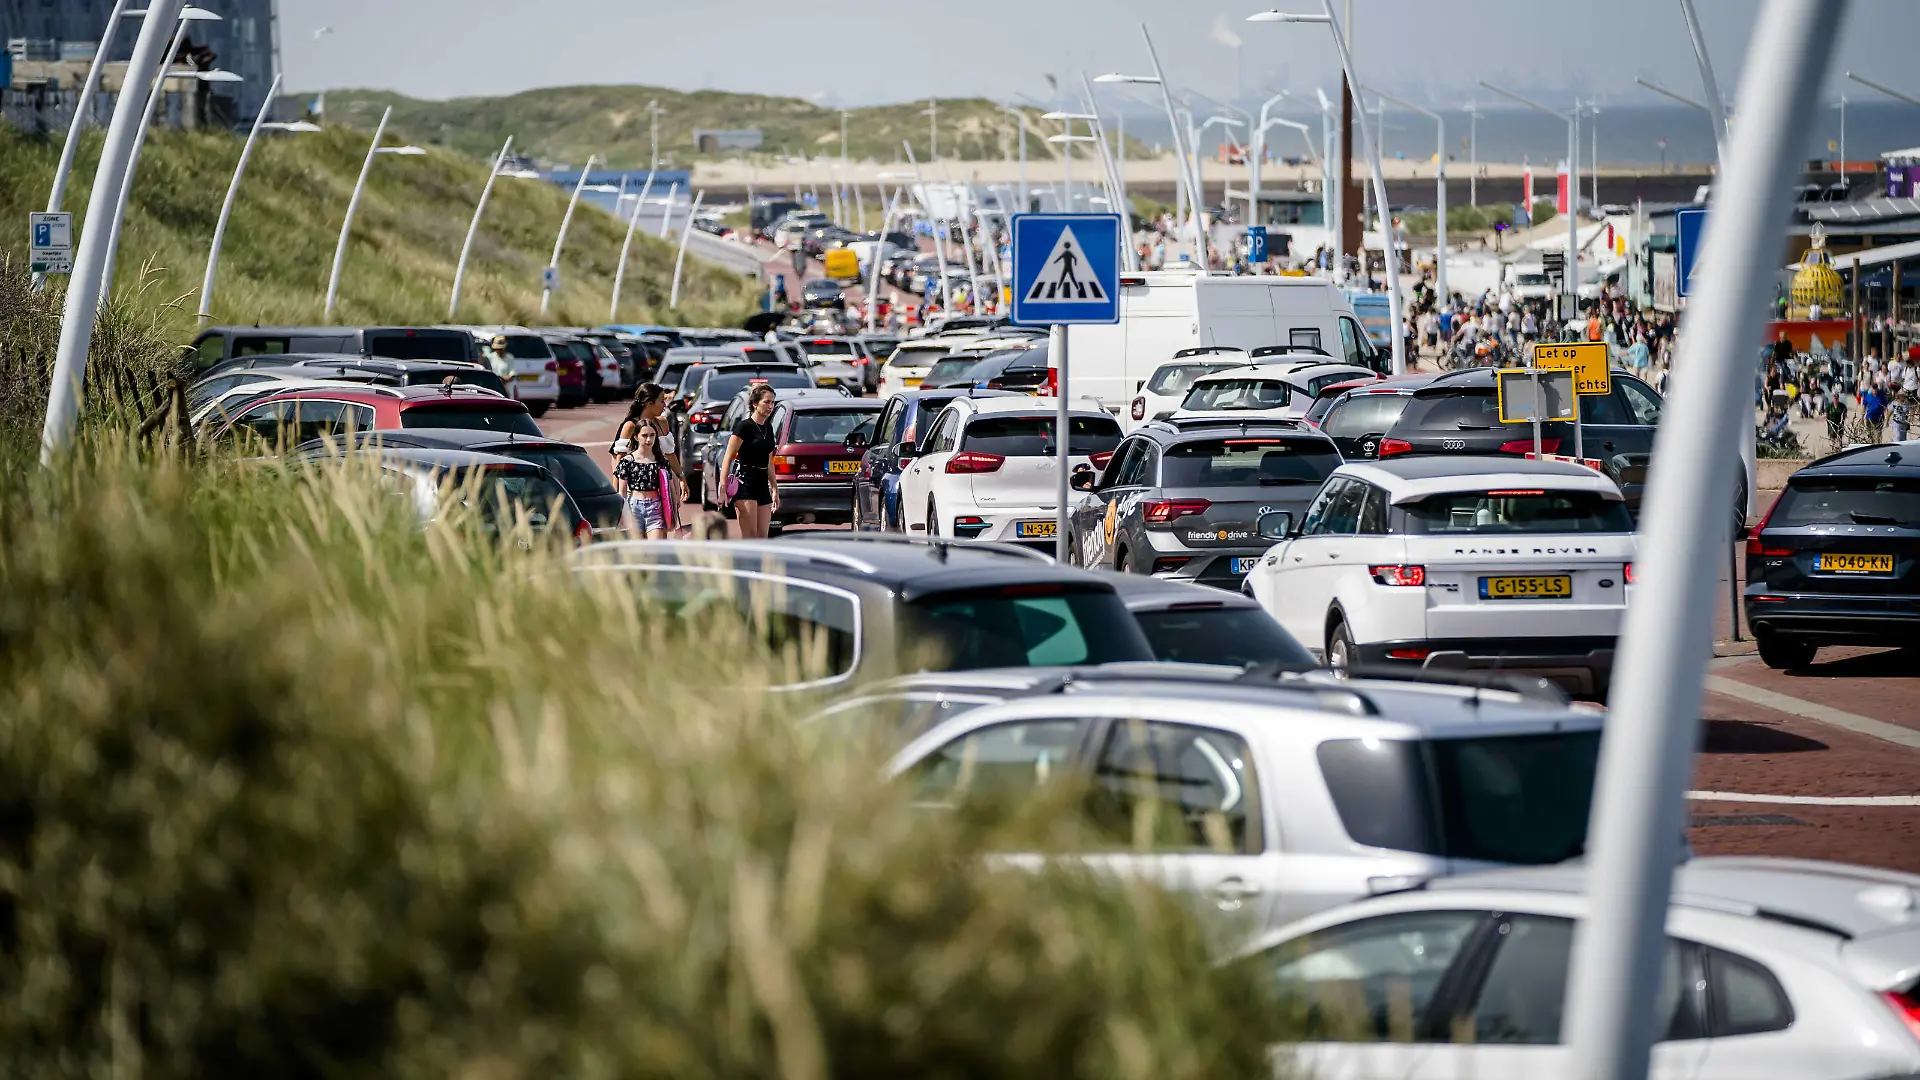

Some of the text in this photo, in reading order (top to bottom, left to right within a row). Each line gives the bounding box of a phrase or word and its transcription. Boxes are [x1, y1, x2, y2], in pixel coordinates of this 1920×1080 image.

[1538, 348, 1577, 359] Let op
[1188, 530, 1248, 540] friendly drive
[1823, 555, 1890, 570] N-040-KN
[1495, 578, 1563, 594] G-155-LS
